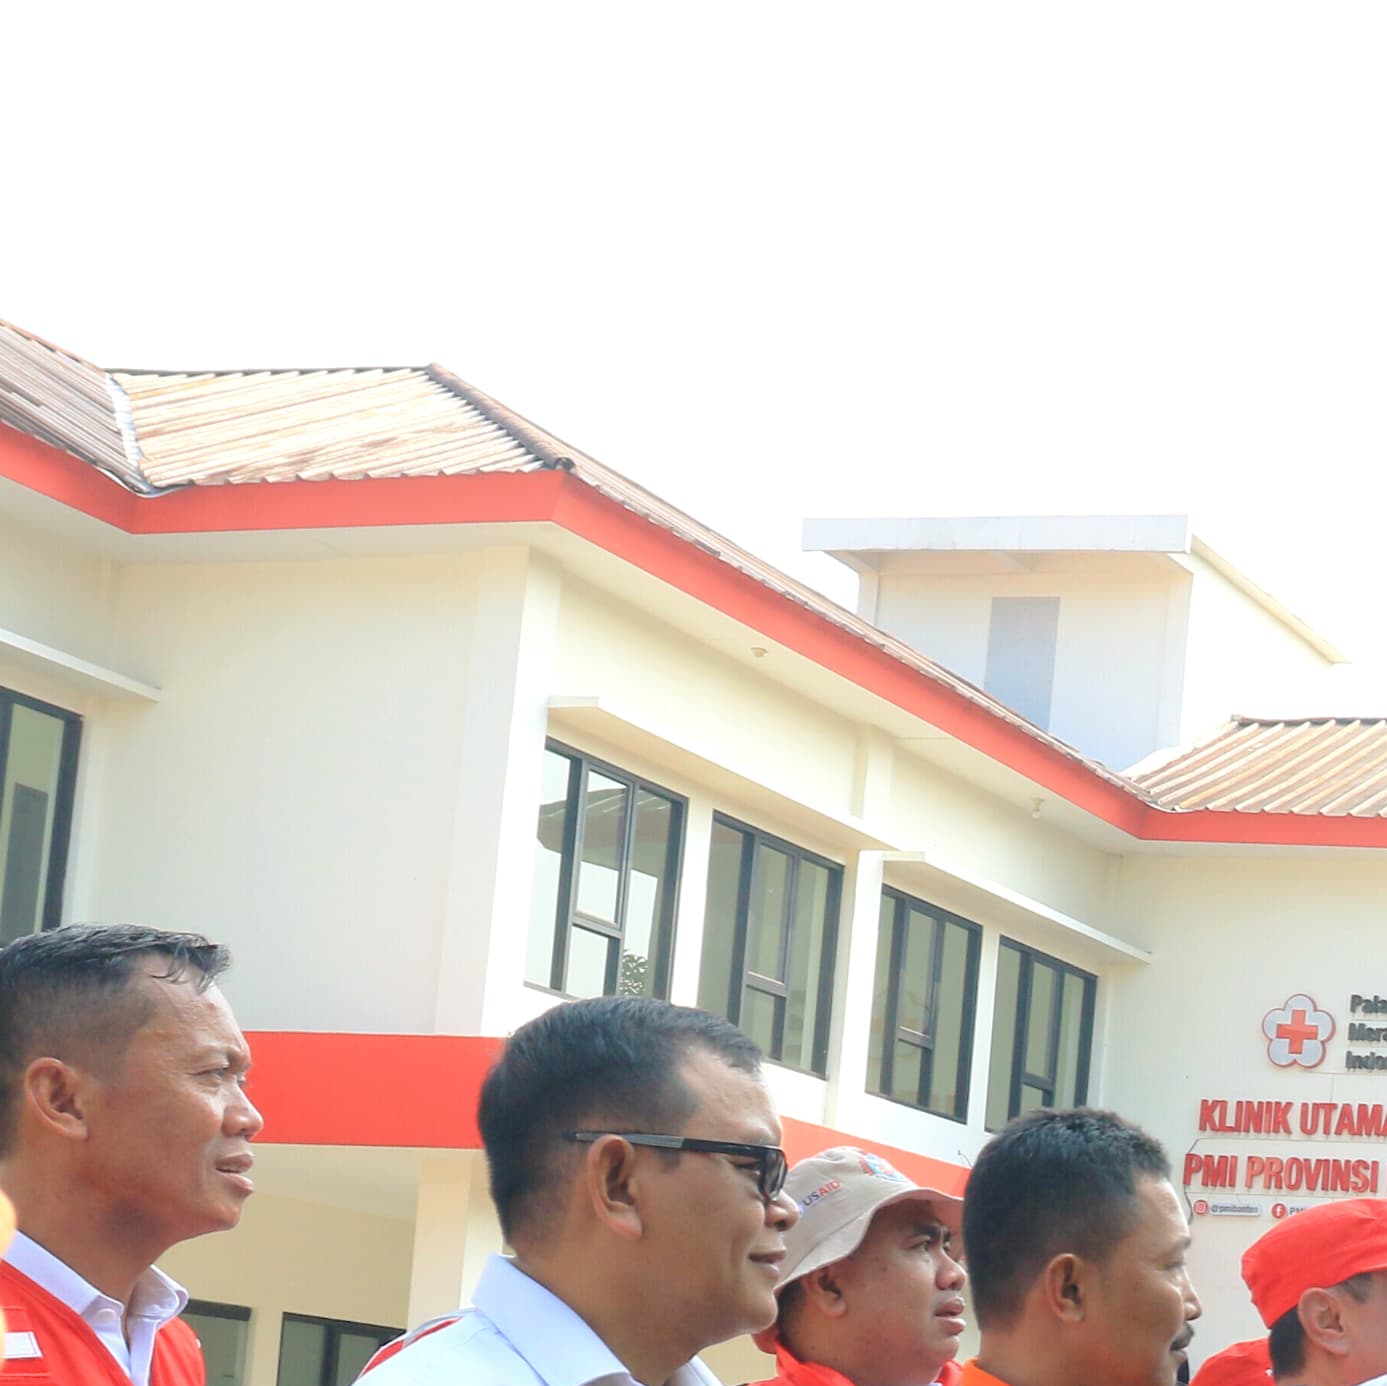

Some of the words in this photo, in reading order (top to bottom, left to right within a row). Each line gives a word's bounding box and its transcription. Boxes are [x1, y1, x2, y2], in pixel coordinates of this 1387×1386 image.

[1199, 1099, 1294, 1135] KLINIK
[1183, 1153, 1238, 1188] PMI
[1245, 1156, 1379, 1194] PROVINSI
[801, 1180, 841, 1206] USAID
